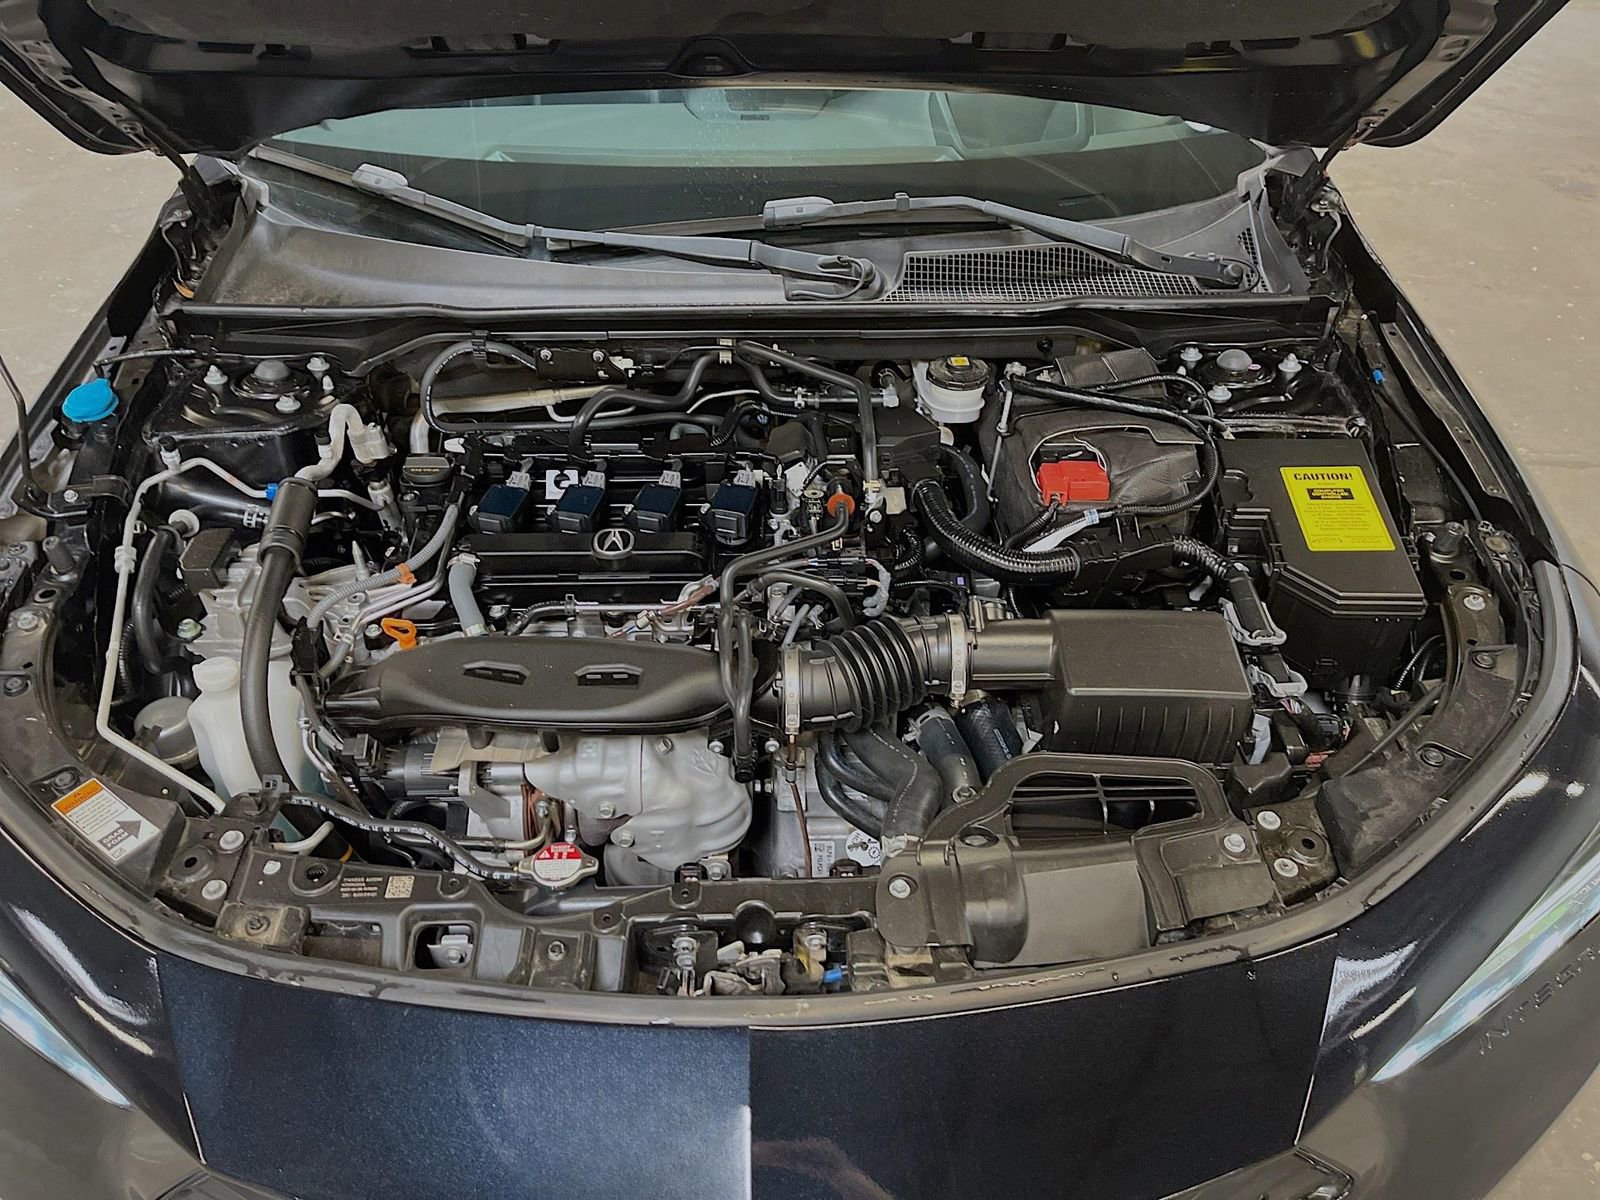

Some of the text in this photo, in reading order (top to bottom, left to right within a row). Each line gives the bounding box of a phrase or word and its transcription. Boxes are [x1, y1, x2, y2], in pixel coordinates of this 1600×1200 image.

[1293, 472, 1353, 481] CAUTION!
[102, 828, 124, 844] GRAB
[107, 832, 130, 848] FOAM
[1479, 946, 1600, 1056] INTEGR
